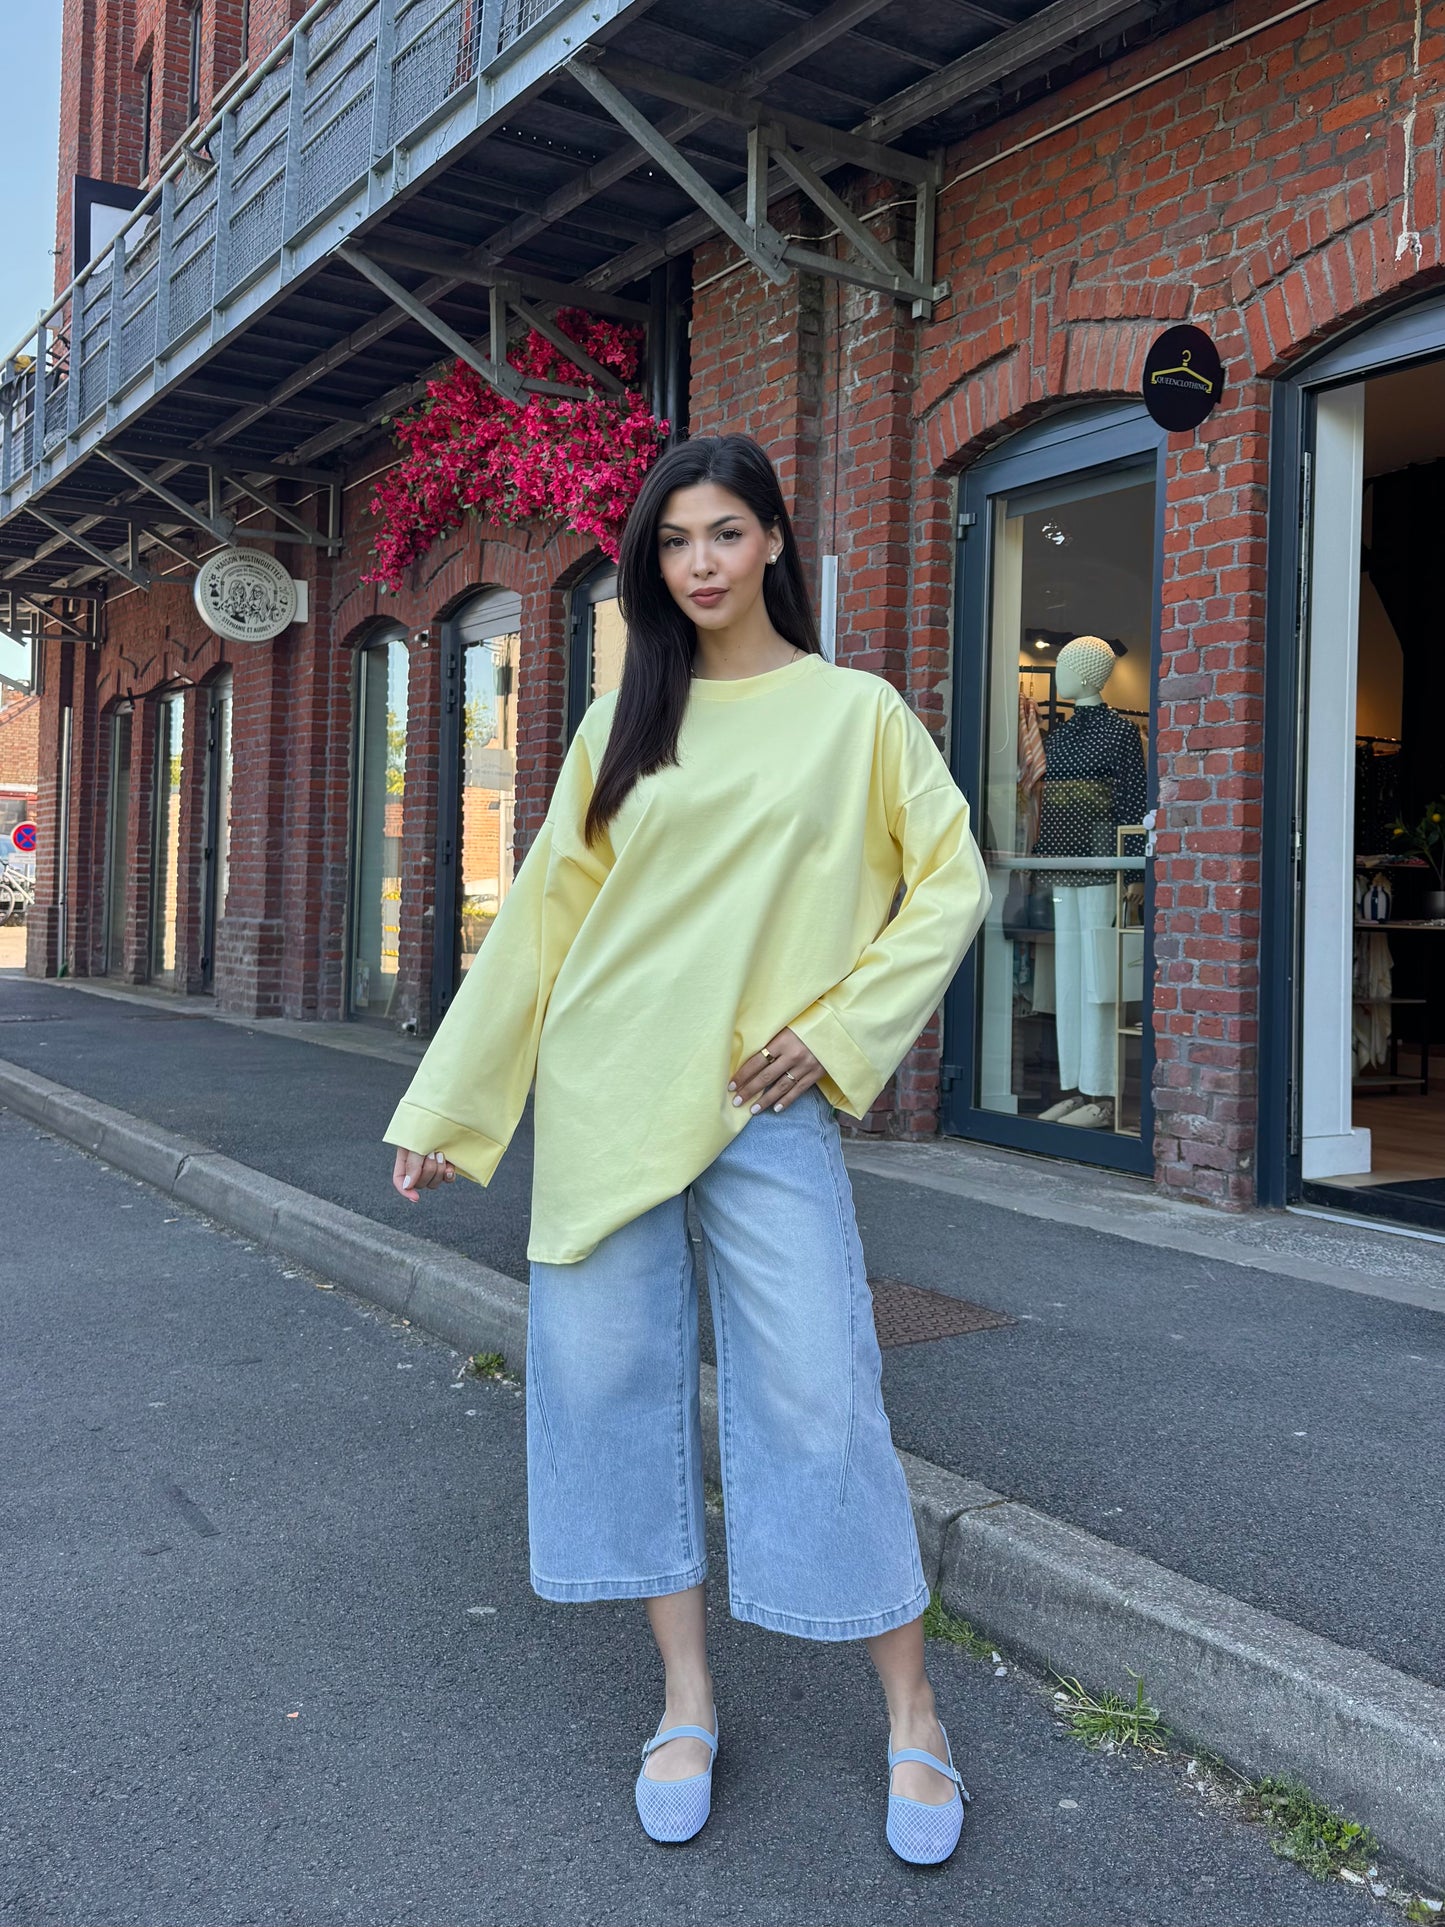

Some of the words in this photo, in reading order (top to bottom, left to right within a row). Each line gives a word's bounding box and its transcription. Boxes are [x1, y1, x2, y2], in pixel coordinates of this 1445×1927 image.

[1156, 376, 1208, 391] QUEENCLOTHING
[215, 555, 238, 572] MAISON
[239, 554, 284, 580] MISTINGUETTES
[254, 624, 272, 633] AUDREY
